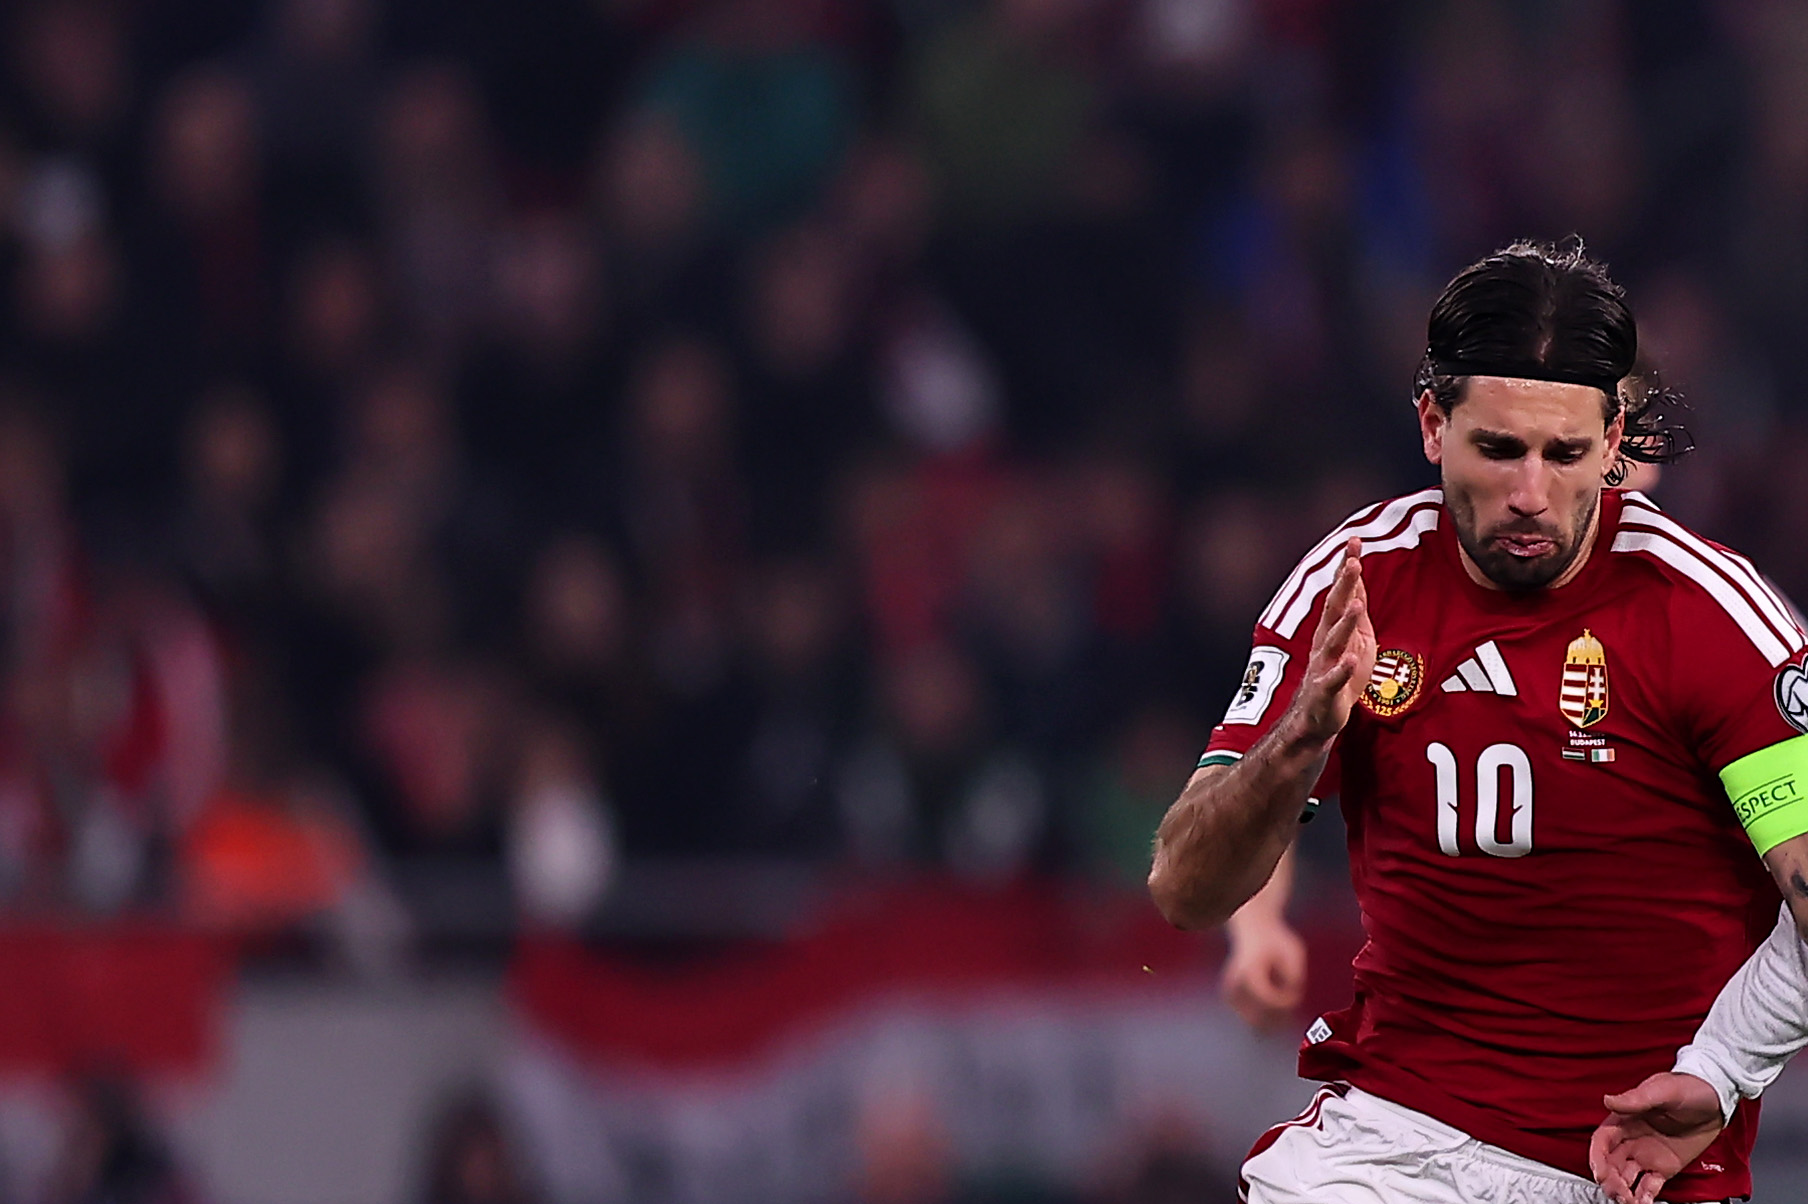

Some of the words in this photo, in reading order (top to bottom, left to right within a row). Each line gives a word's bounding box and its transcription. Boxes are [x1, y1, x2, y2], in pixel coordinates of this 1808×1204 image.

[1375, 705, 1393, 716] 125
[1569, 738, 1606, 746] BUDAPEST
[1426, 741, 1533, 858] 10
